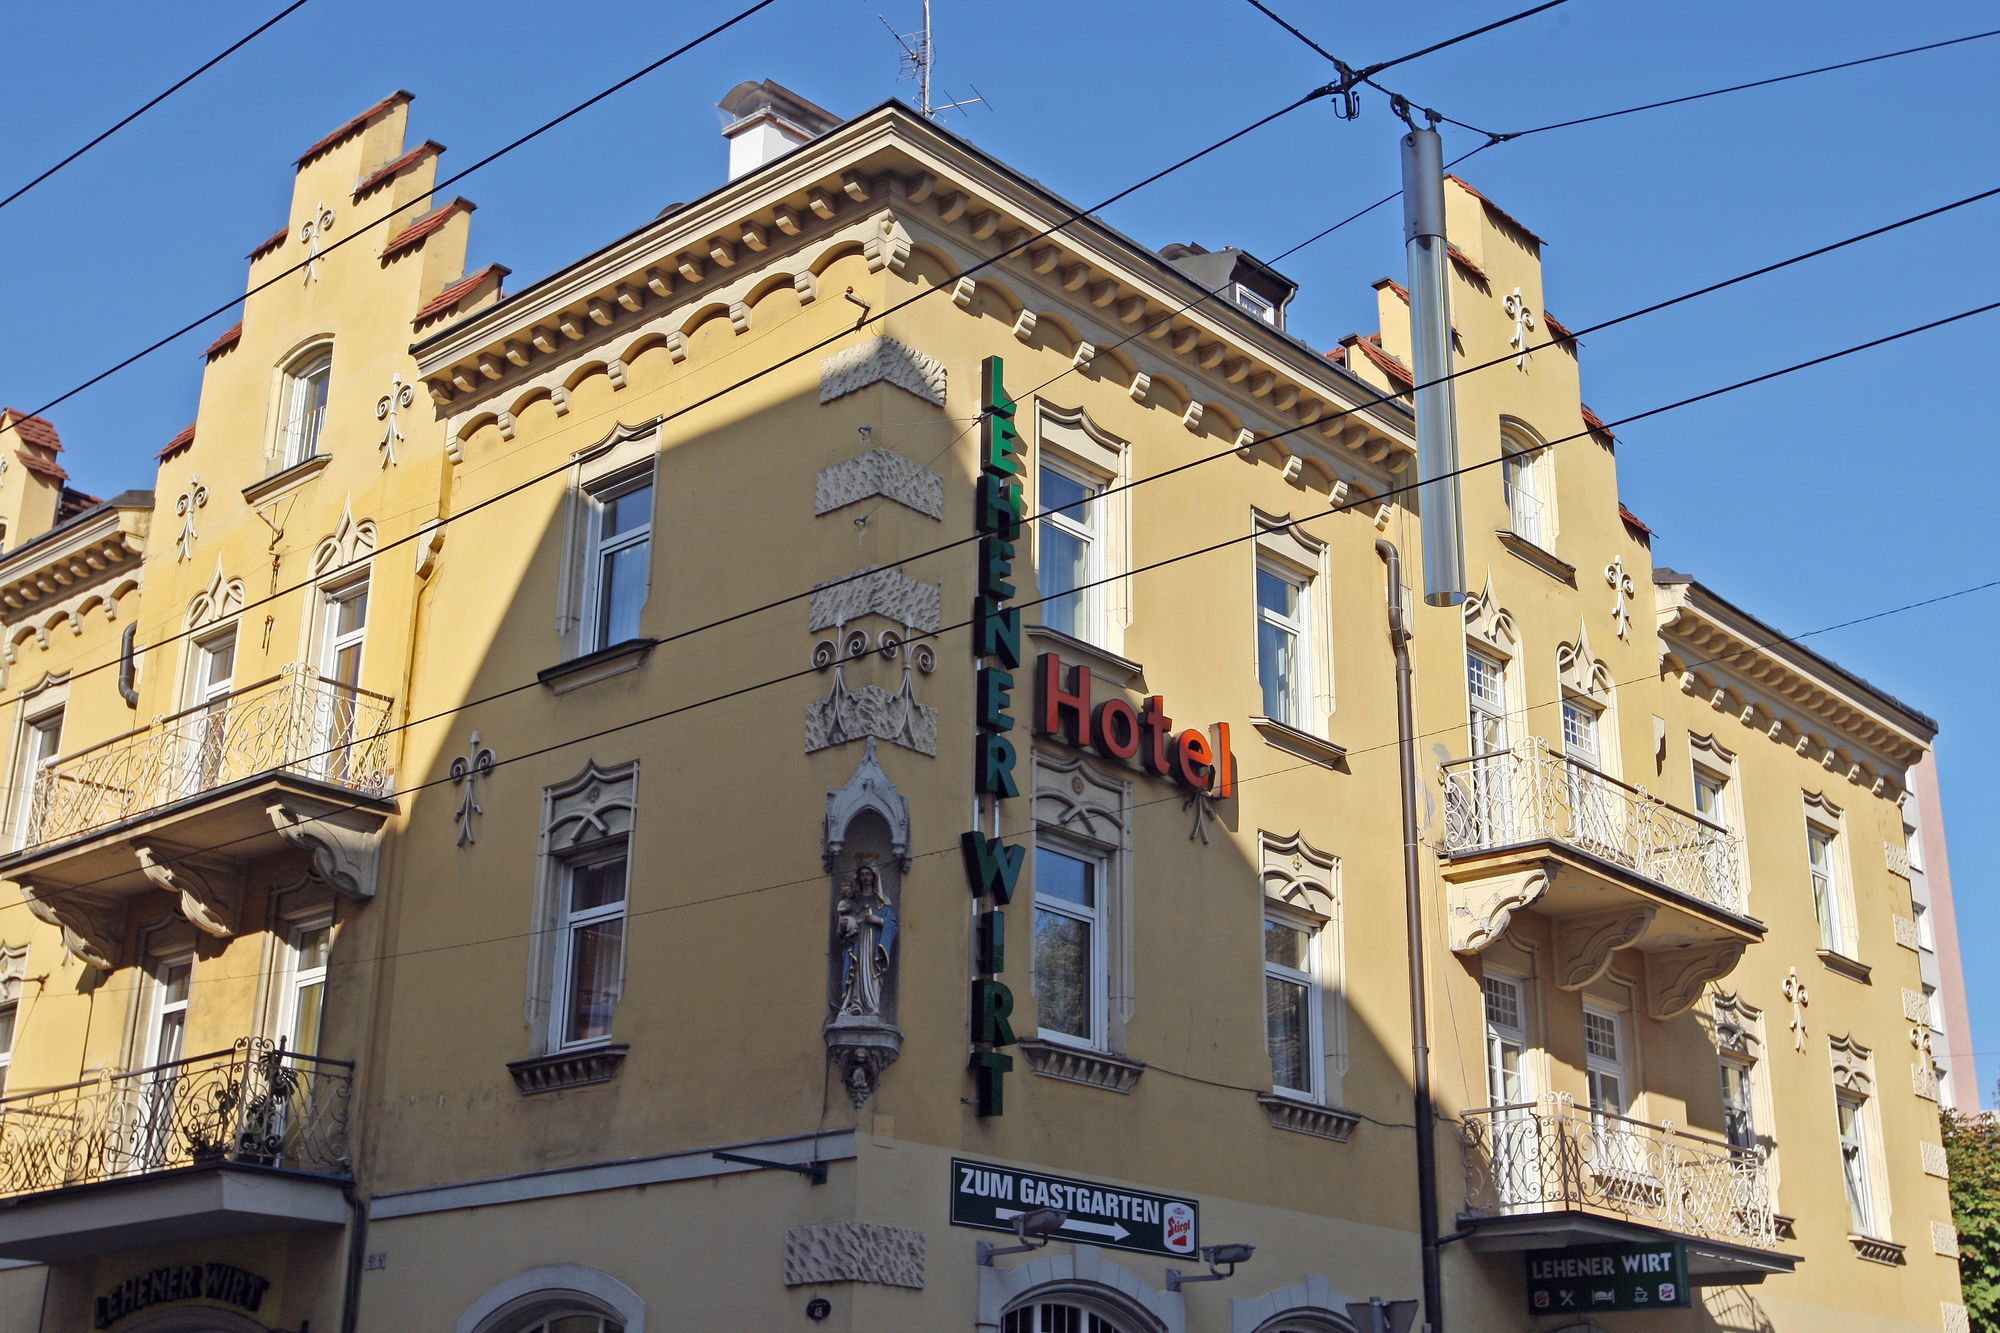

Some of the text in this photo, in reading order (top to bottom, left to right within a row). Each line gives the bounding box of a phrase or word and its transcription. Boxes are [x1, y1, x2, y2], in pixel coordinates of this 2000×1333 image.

[966, 355, 1026, 1117] LEHENER WIRT
[1041, 653, 1232, 798] Hotel
[960, 1167, 1160, 1225] ZUM GASTGARTEN
[1167, 1216, 1191, 1238] Stiegl
[95, 1262, 270, 1329] LEHENER WIRT
[1532, 1252, 1672, 1279] LEHENER WIRT
